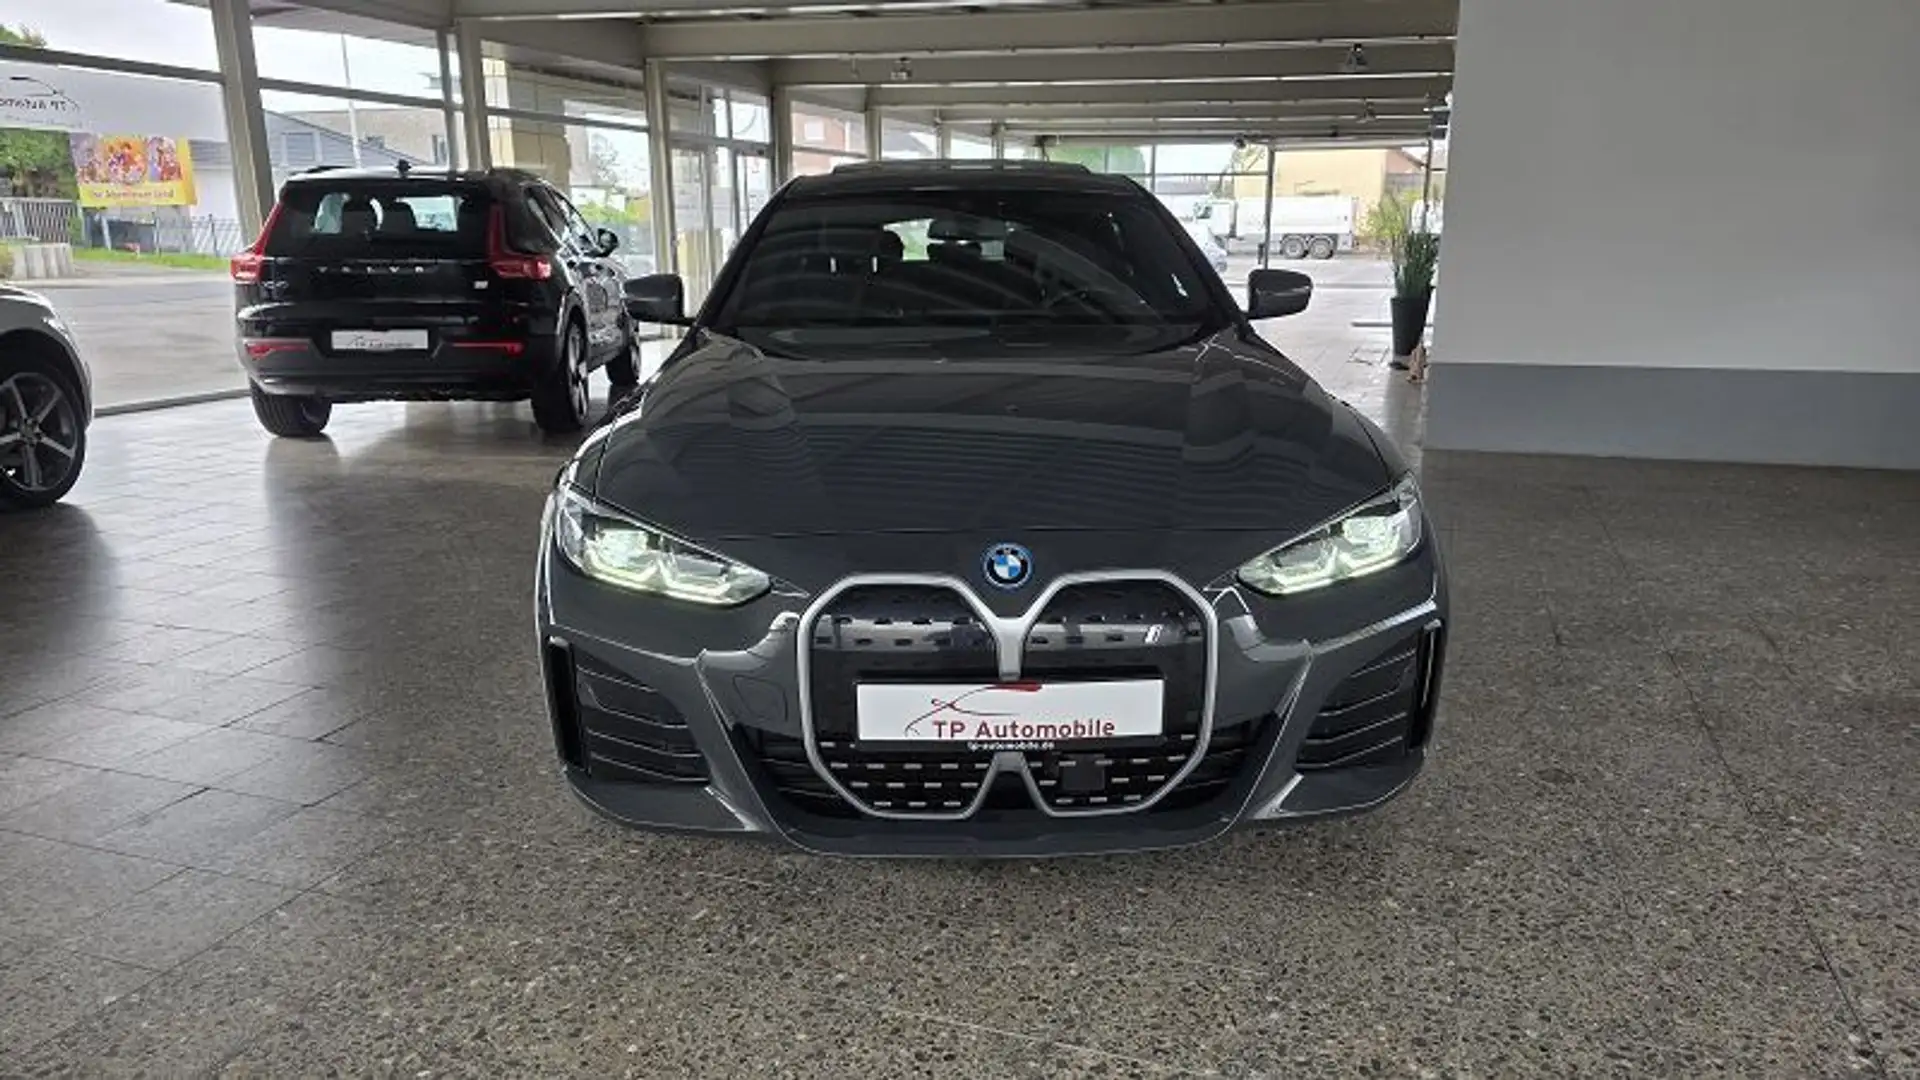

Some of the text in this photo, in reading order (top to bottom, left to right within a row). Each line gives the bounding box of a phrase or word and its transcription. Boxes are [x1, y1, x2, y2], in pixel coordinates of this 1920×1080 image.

[932, 718, 1115, 738] TP Automobile
[966, 741, 1055, 751] tp-automobile.de
